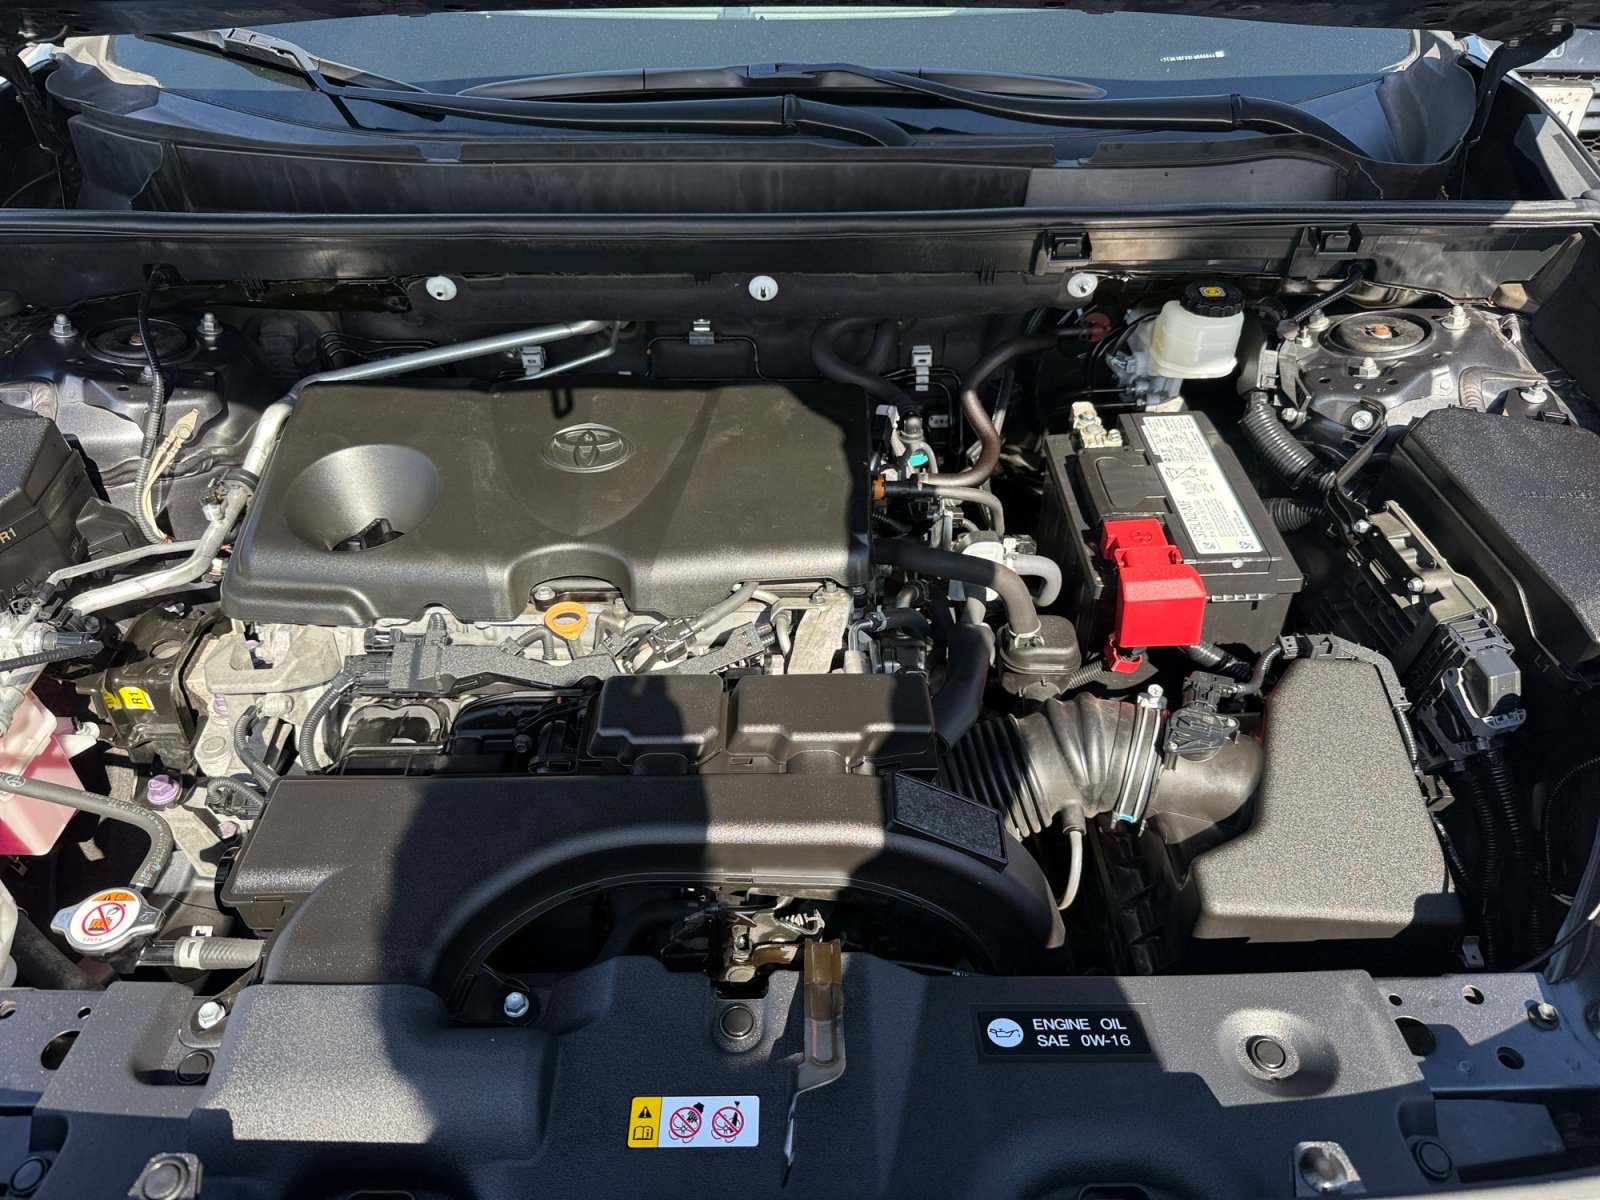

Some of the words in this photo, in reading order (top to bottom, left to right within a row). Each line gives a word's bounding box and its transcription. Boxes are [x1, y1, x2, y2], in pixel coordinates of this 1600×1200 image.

[1177, 499, 1207, 538] 375LN2-MF
[0, 527, 17, 544] R1
[128, 692, 144, 705] R1
[1032, 1018, 1091, 1030] ENGINE
[1100, 1018, 1127, 1030] OIL
[1037, 1034, 1070, 1047] SAE
[1081, 1034, 1131, 1047] 0W-16
